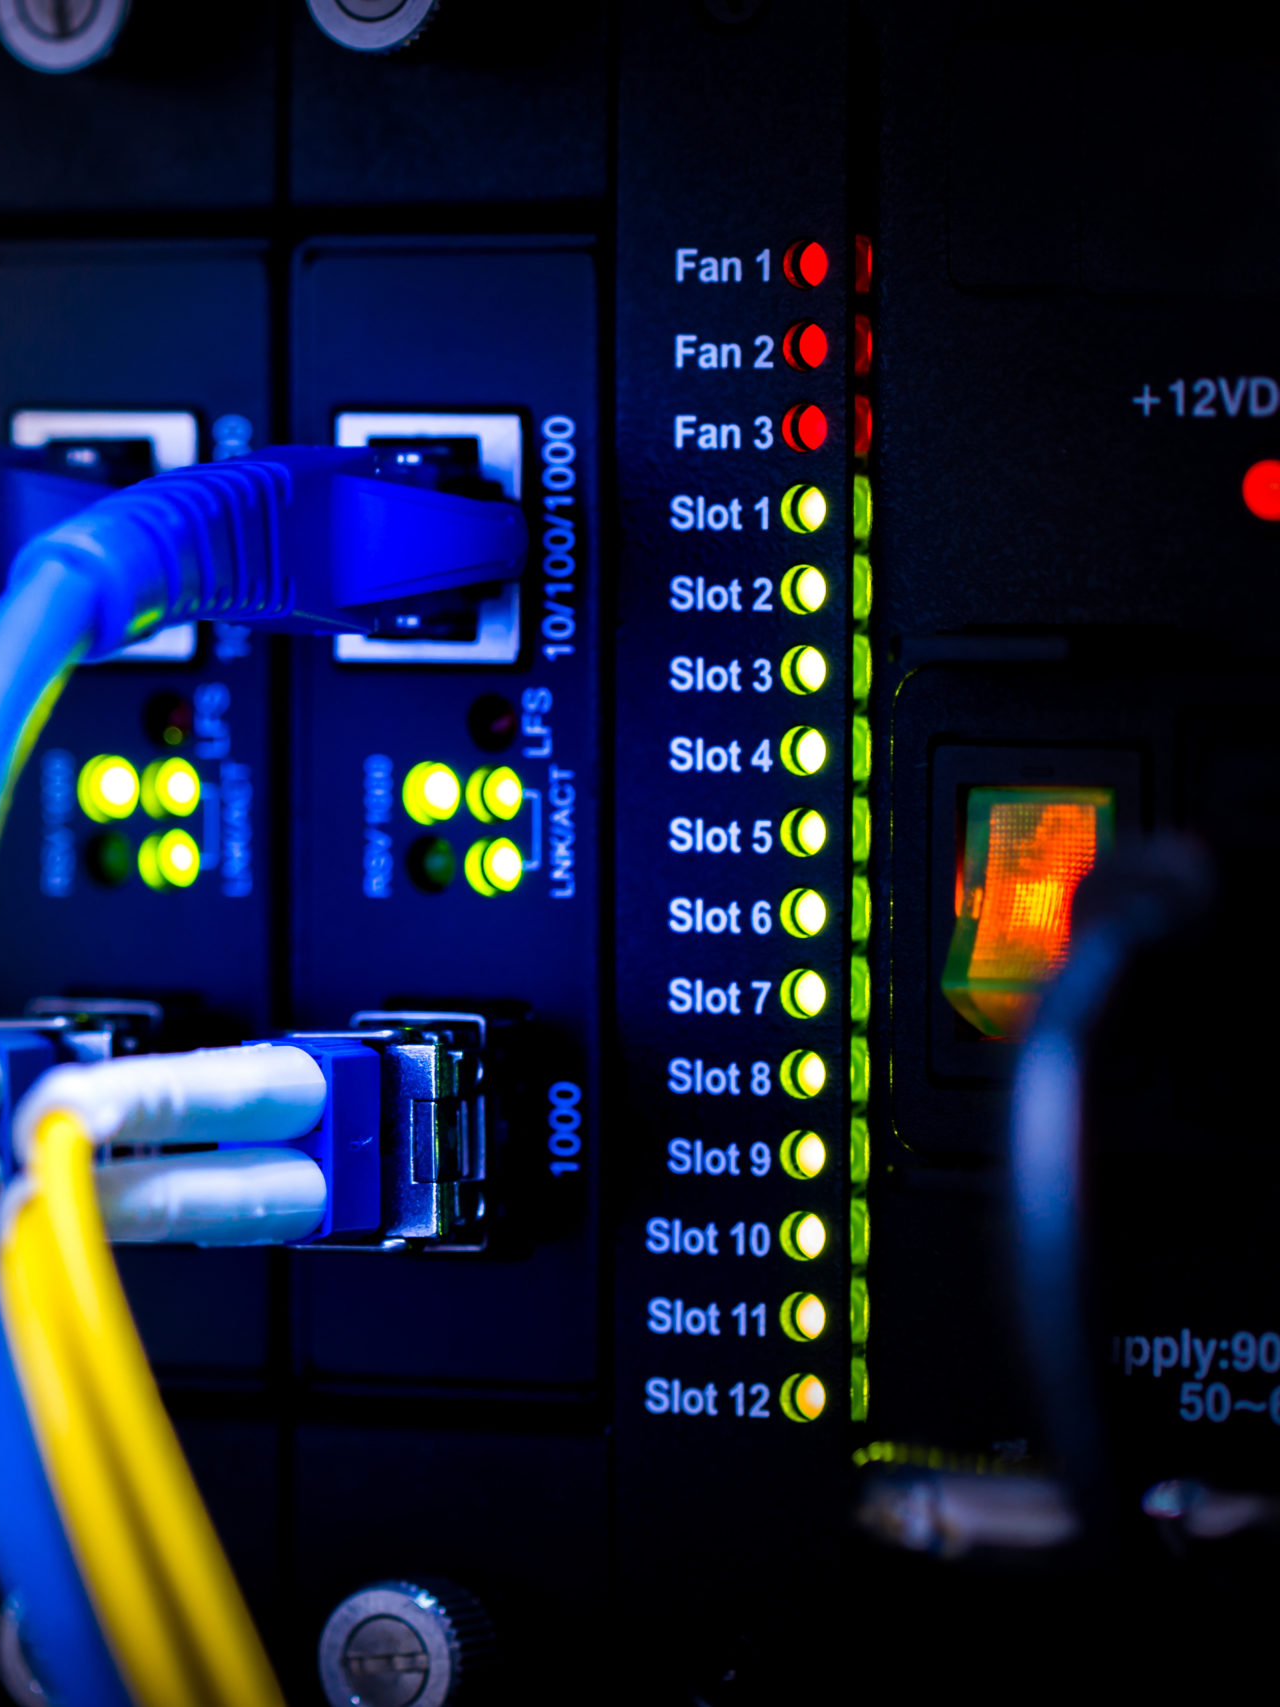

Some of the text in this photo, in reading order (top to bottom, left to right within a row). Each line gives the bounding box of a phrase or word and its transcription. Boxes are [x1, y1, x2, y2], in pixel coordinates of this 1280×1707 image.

[675, 247, 771, 283] Fan 1
[675, 334, 775, 370] Fan 2
[674, 414, 774, 451] Fan 3
[670, 494, 770, 531] Slot 1
[541, 414, 576, 661] 10/100/1000
[670, 575, 774, 612] Slot 2
[669, 656, 773, 693] Slot 3
[522, 688, 553, 758] LFS
[669, 736, 774, 773] Slot 4
[549, 764, 576, 898] LNK/ACT
[668, 816, 773, 854] Slot 5
[668, 897, 773, 935] Slot 6
[668, 977, 772, 1015] Slot 7
[668, 1057, 772, 1097] Slot 8
[548, 1081, 582, 1177] 1000
[667, 1137, 772, 1177] Slot 9
[646, 1217, 771, 1258] Slot 10
[647, 1297, 767, 1337] Slot 11
[1113, 1327, 1280, 1381] pply:90
[645, 1377, 771, 1418] Slot 12
